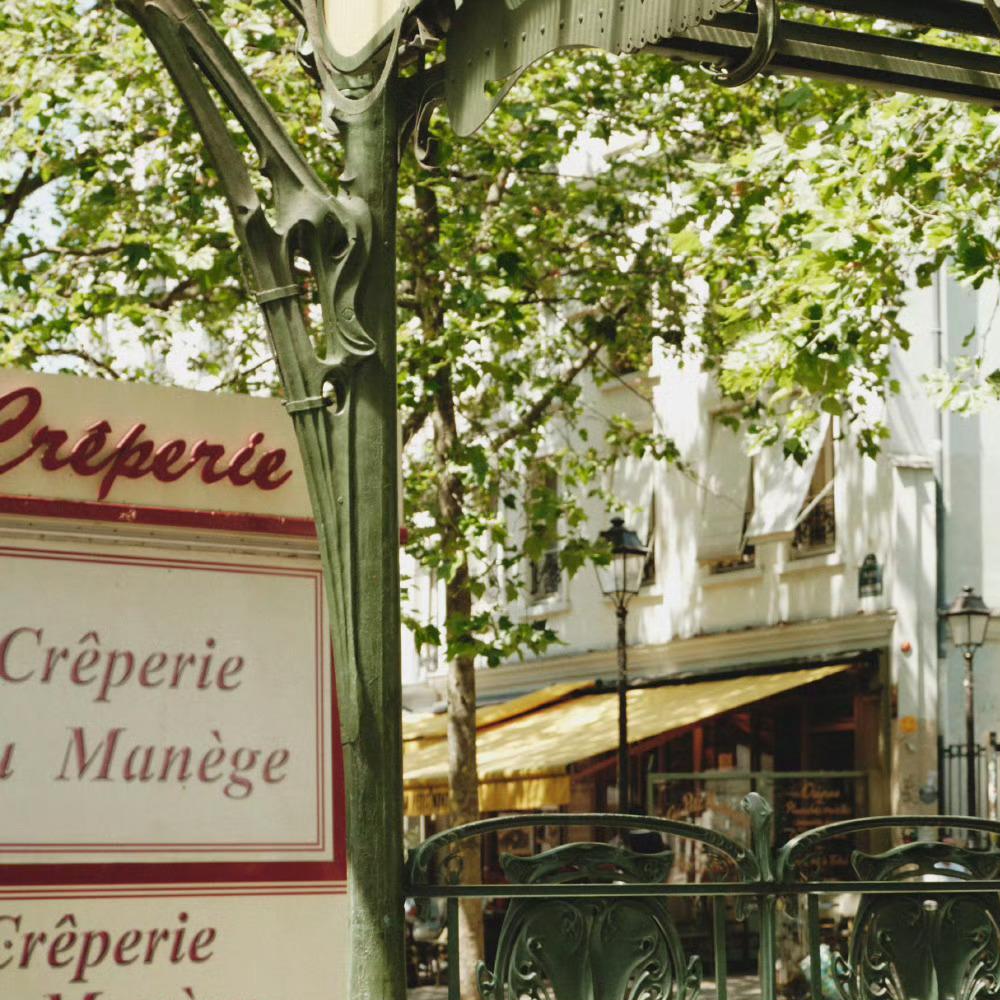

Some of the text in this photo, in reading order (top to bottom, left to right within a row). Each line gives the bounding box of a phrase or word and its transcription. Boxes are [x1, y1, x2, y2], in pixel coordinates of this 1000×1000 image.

[0, 387, 293, 501] Crêperie
[0, 626, 245, 703] Crêperie
[54, 727, 290, 800] Manège
